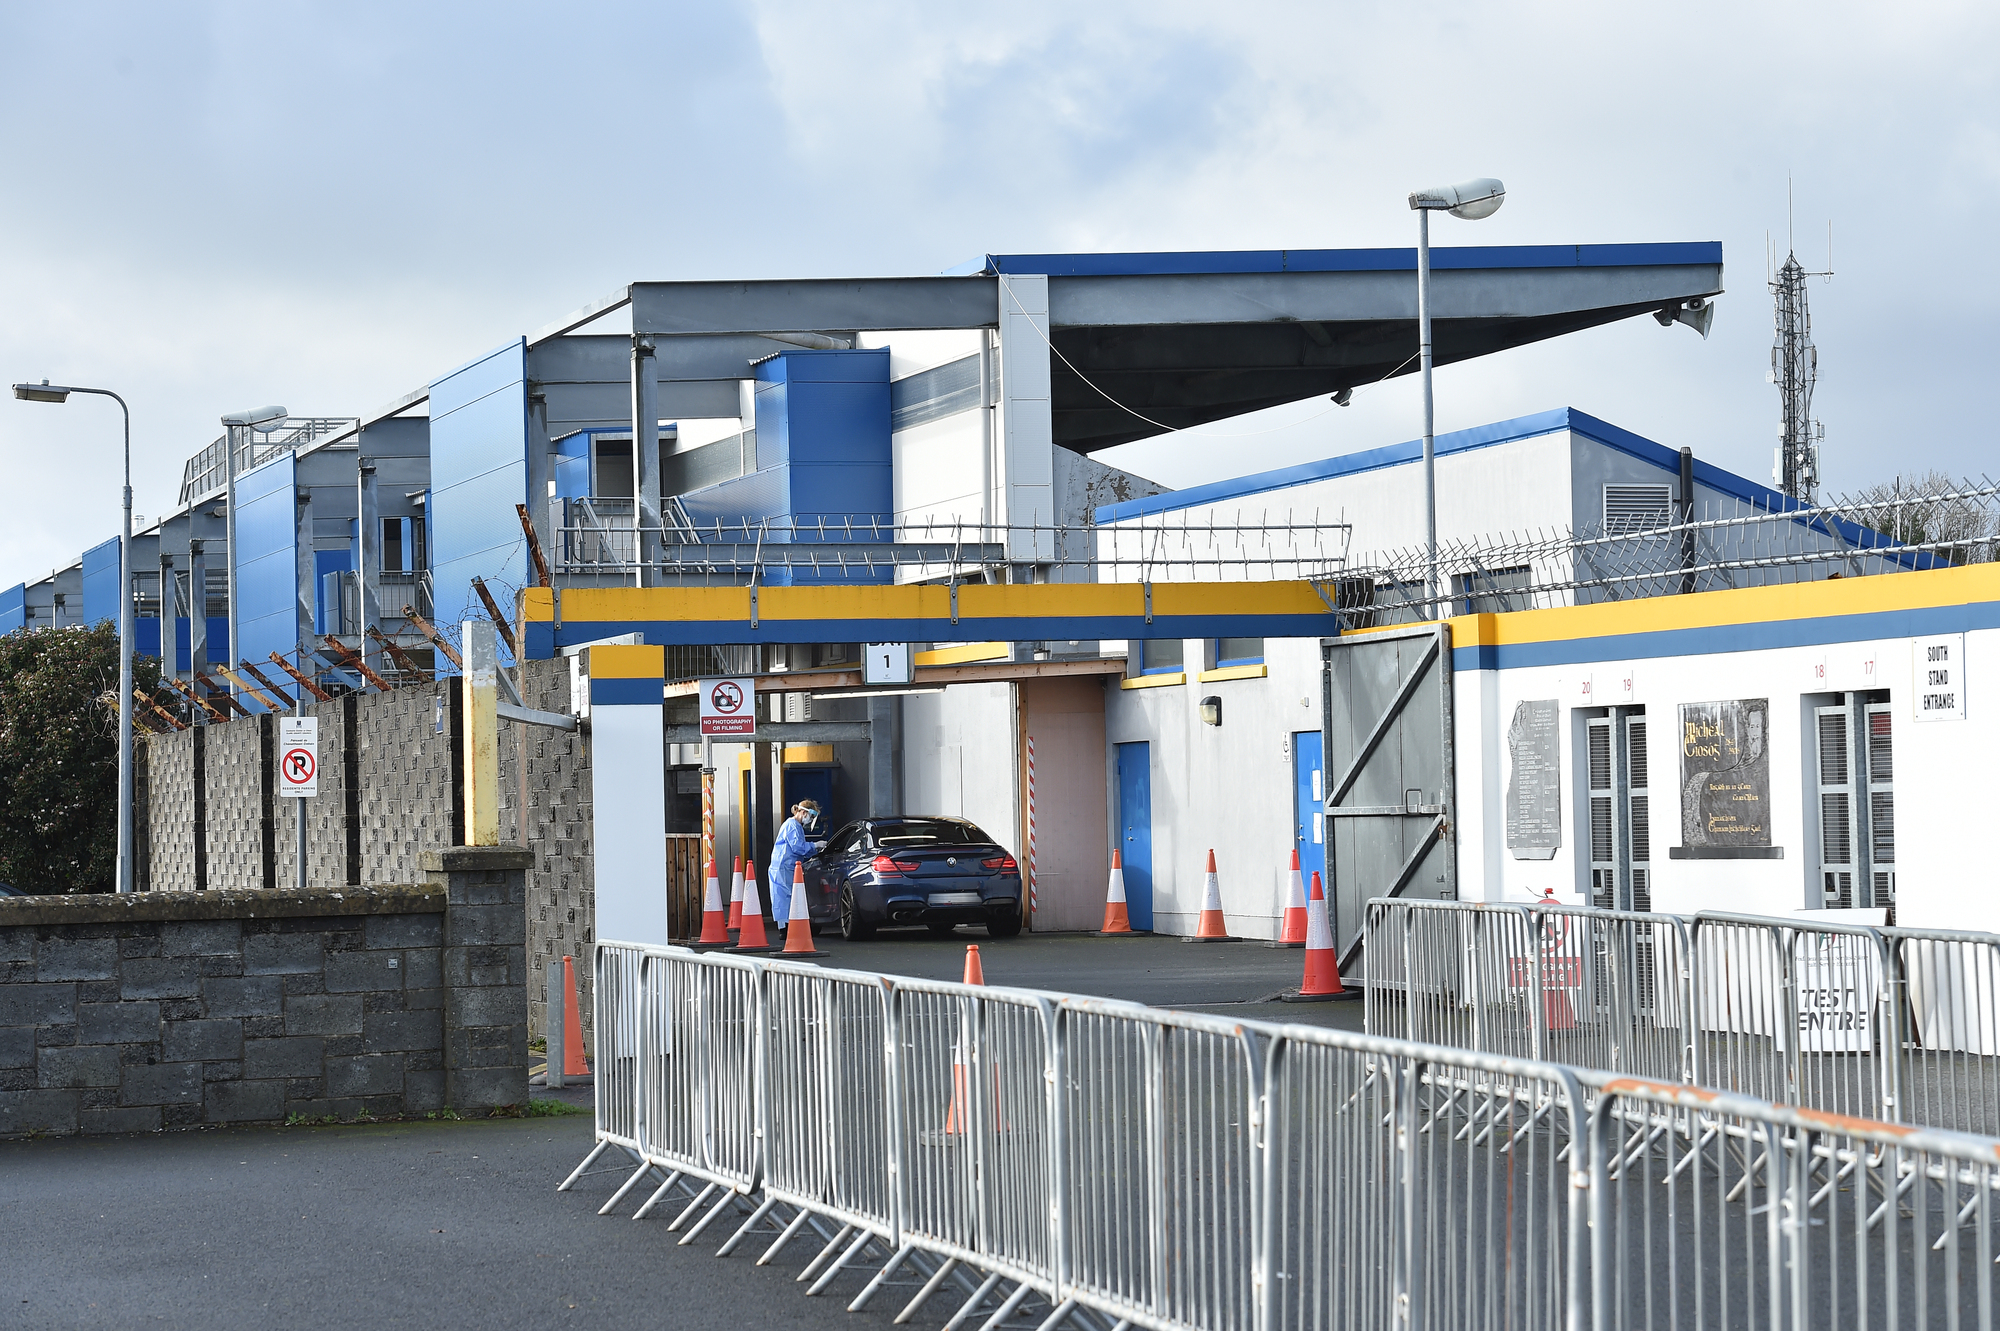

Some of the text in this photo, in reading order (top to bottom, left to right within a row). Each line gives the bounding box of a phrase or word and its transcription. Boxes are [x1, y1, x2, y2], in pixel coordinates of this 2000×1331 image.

[883, 654, 890, 669] 1
[1927, 645, 1948, 662] SOUTH
[1815, 664, 1825, 678] 18
[1864, 660, 1874, 674] 17
[1623, 678, 1631, 691] 19
[1928, 669, 1948, 686] STAND
[1582, 681, 1591, 694] 20
[1923, 693, 1954, 710] ENTRANCE
[1802, 988, 1855, 1008] TEST
[1798, 1011, 1867, 1031] ENTRE
